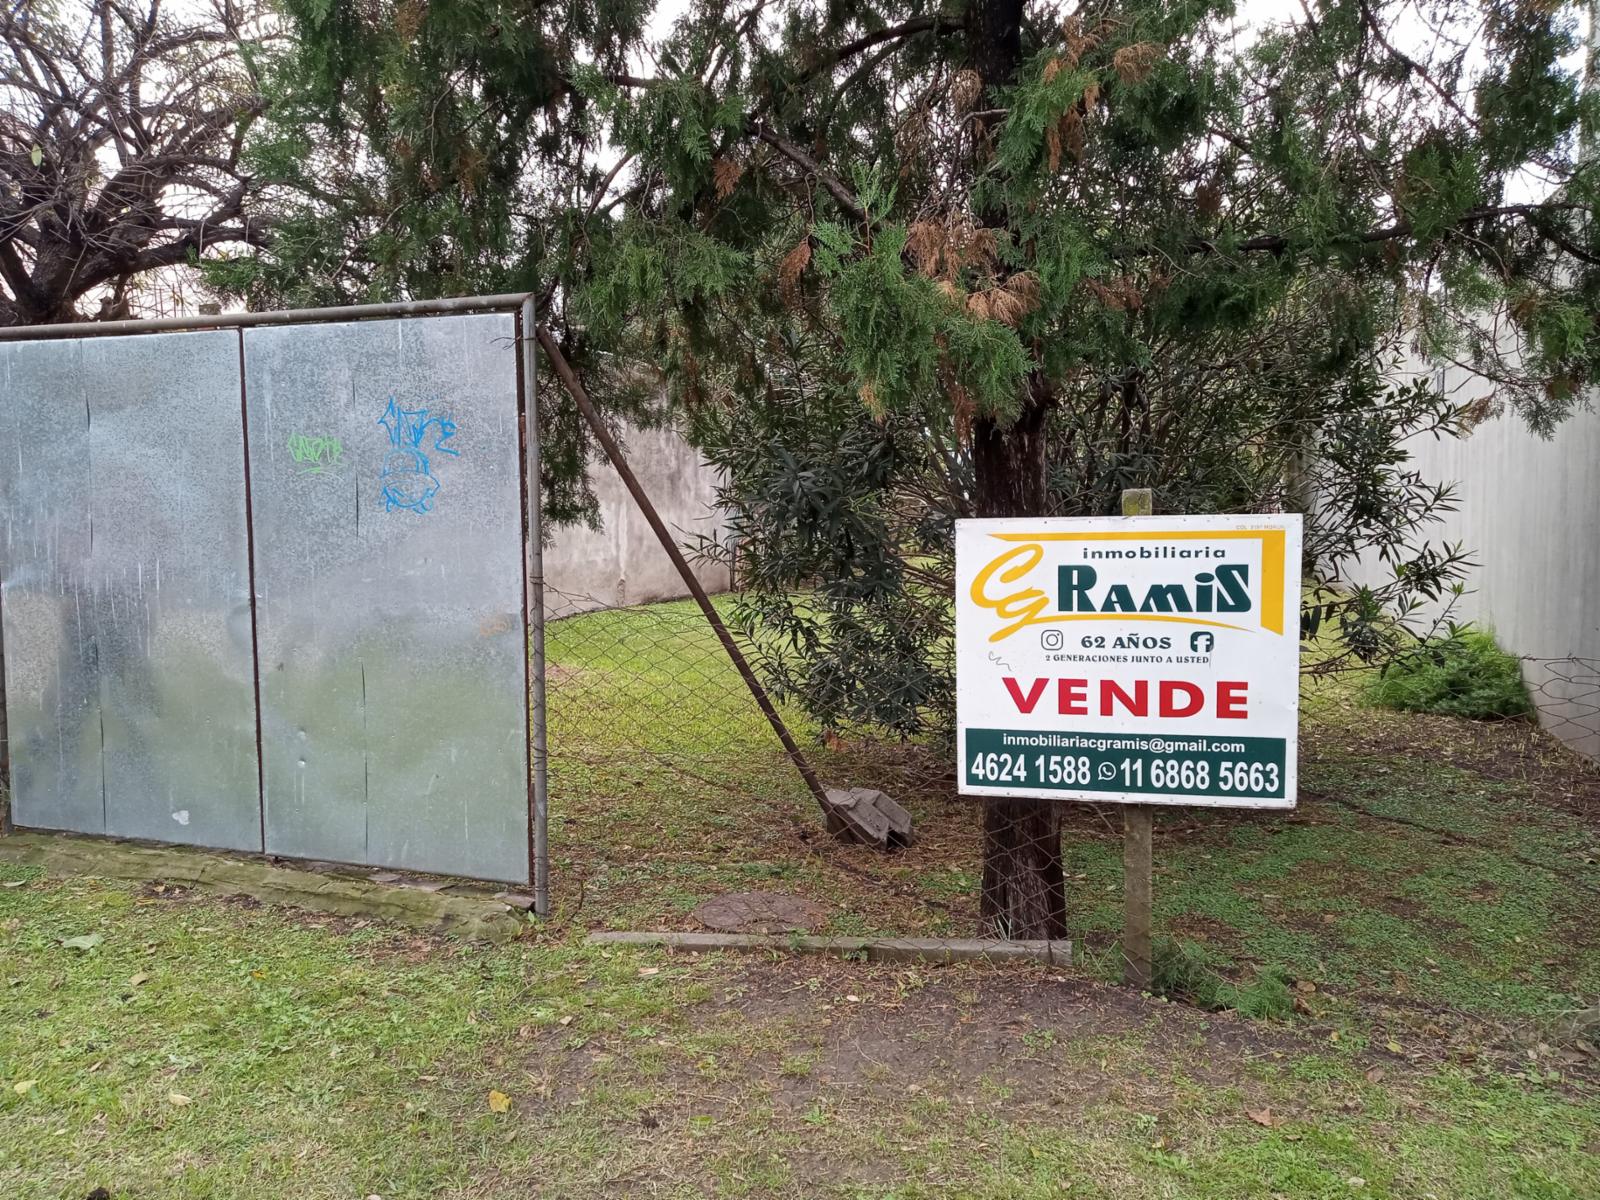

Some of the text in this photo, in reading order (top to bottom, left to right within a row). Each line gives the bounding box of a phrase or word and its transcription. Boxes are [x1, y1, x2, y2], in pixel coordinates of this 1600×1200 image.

[1083, 547, 1226, 559] inmobiliaria
[1081, 633, 1171, 649] 62 AÑOS
[1053, 655, 1128, 663] GENERACIONES
[1131, 656, 1163, 664] JUNTO
[1176, 656, 1209, 664] USTED
[1002, 678, 1248, 719] VENDE
[1003, 734, 1245, 753] inmobiliariacgramis@gmail.com
[971, 752, 1279, 792] 4624 1588 11 6868 5663
